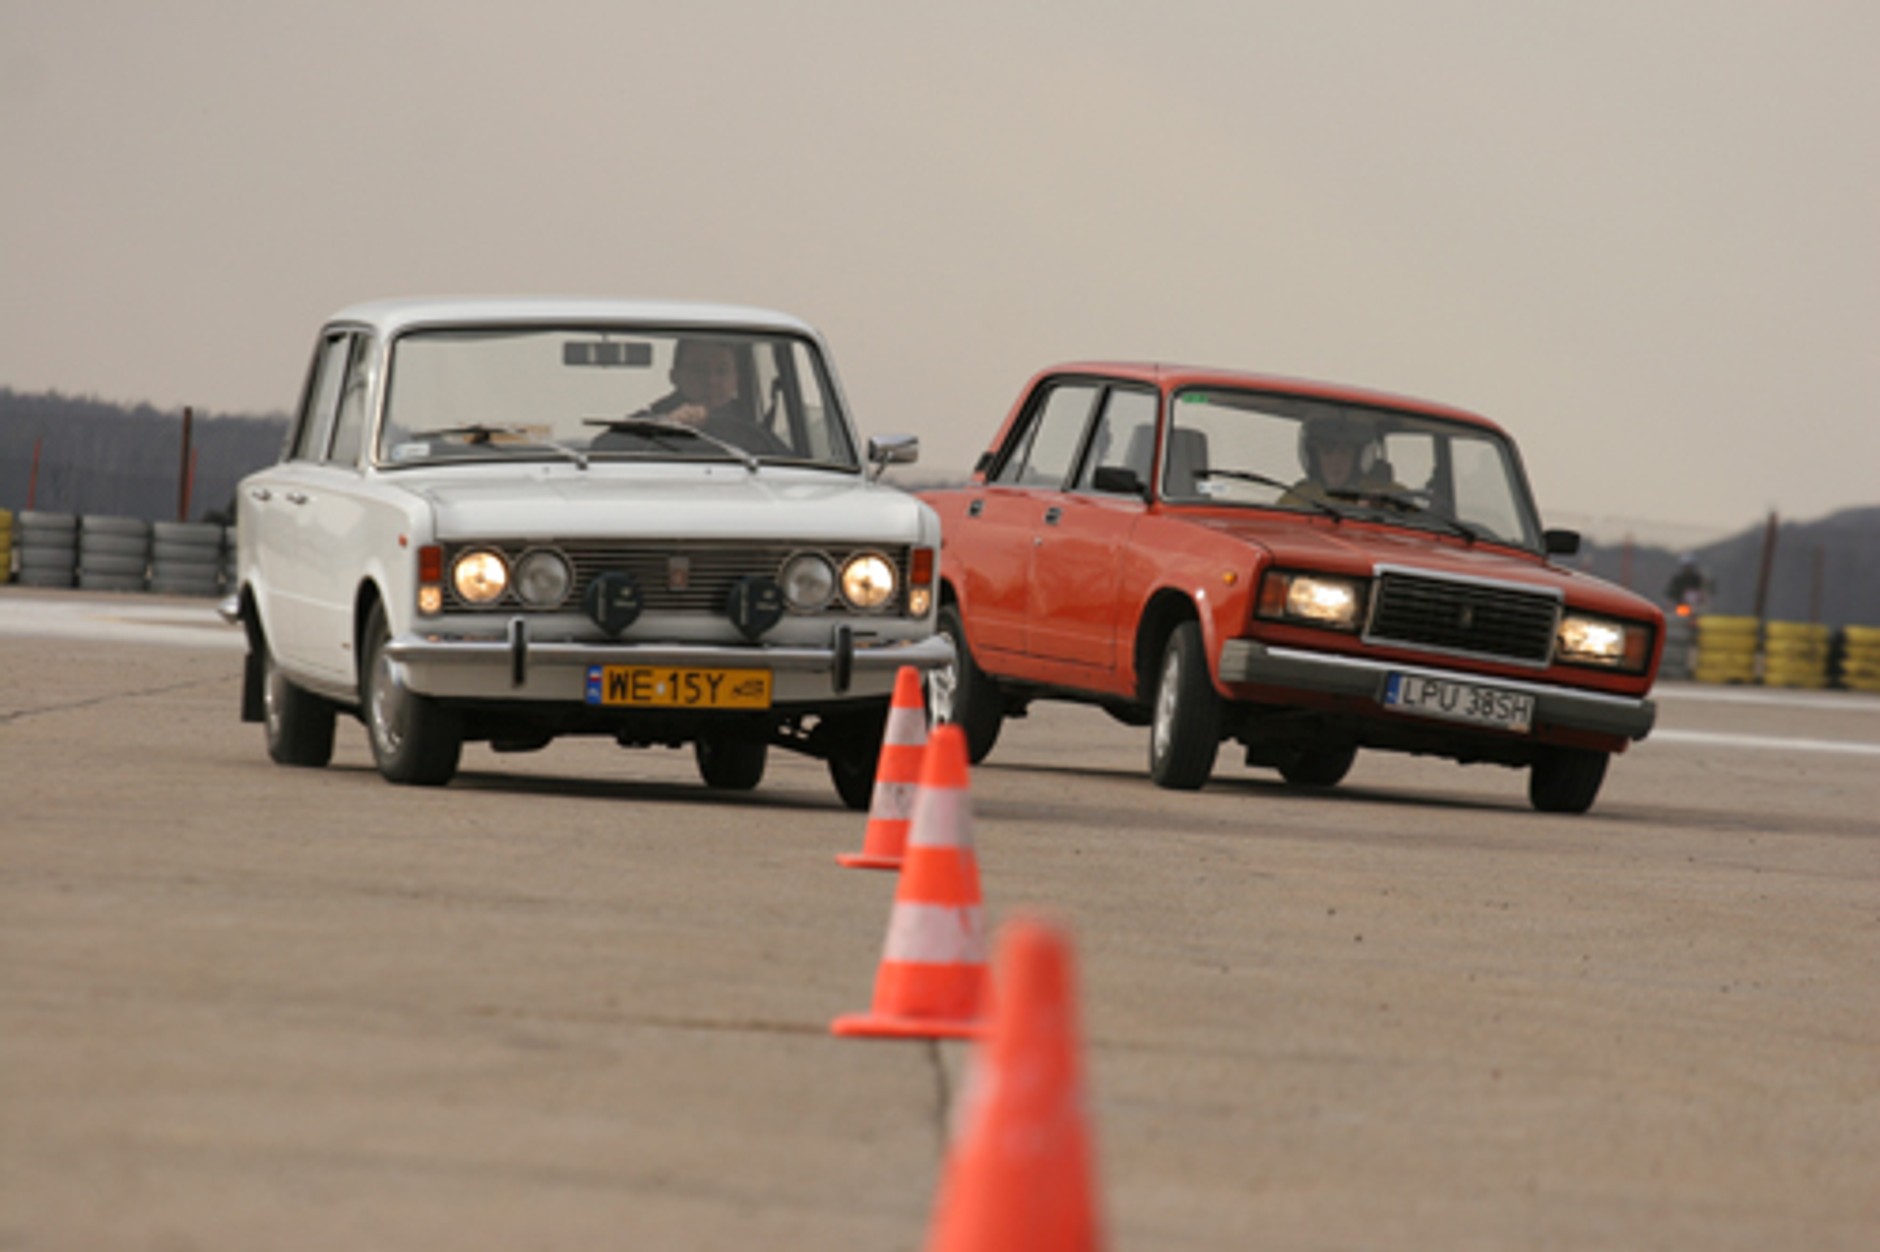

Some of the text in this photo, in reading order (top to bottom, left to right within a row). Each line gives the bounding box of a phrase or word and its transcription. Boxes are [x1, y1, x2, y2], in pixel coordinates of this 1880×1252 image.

[608, 669, 725, 704] WE 15Y
[1402, 678, 1528, 720] LPU 38SH
